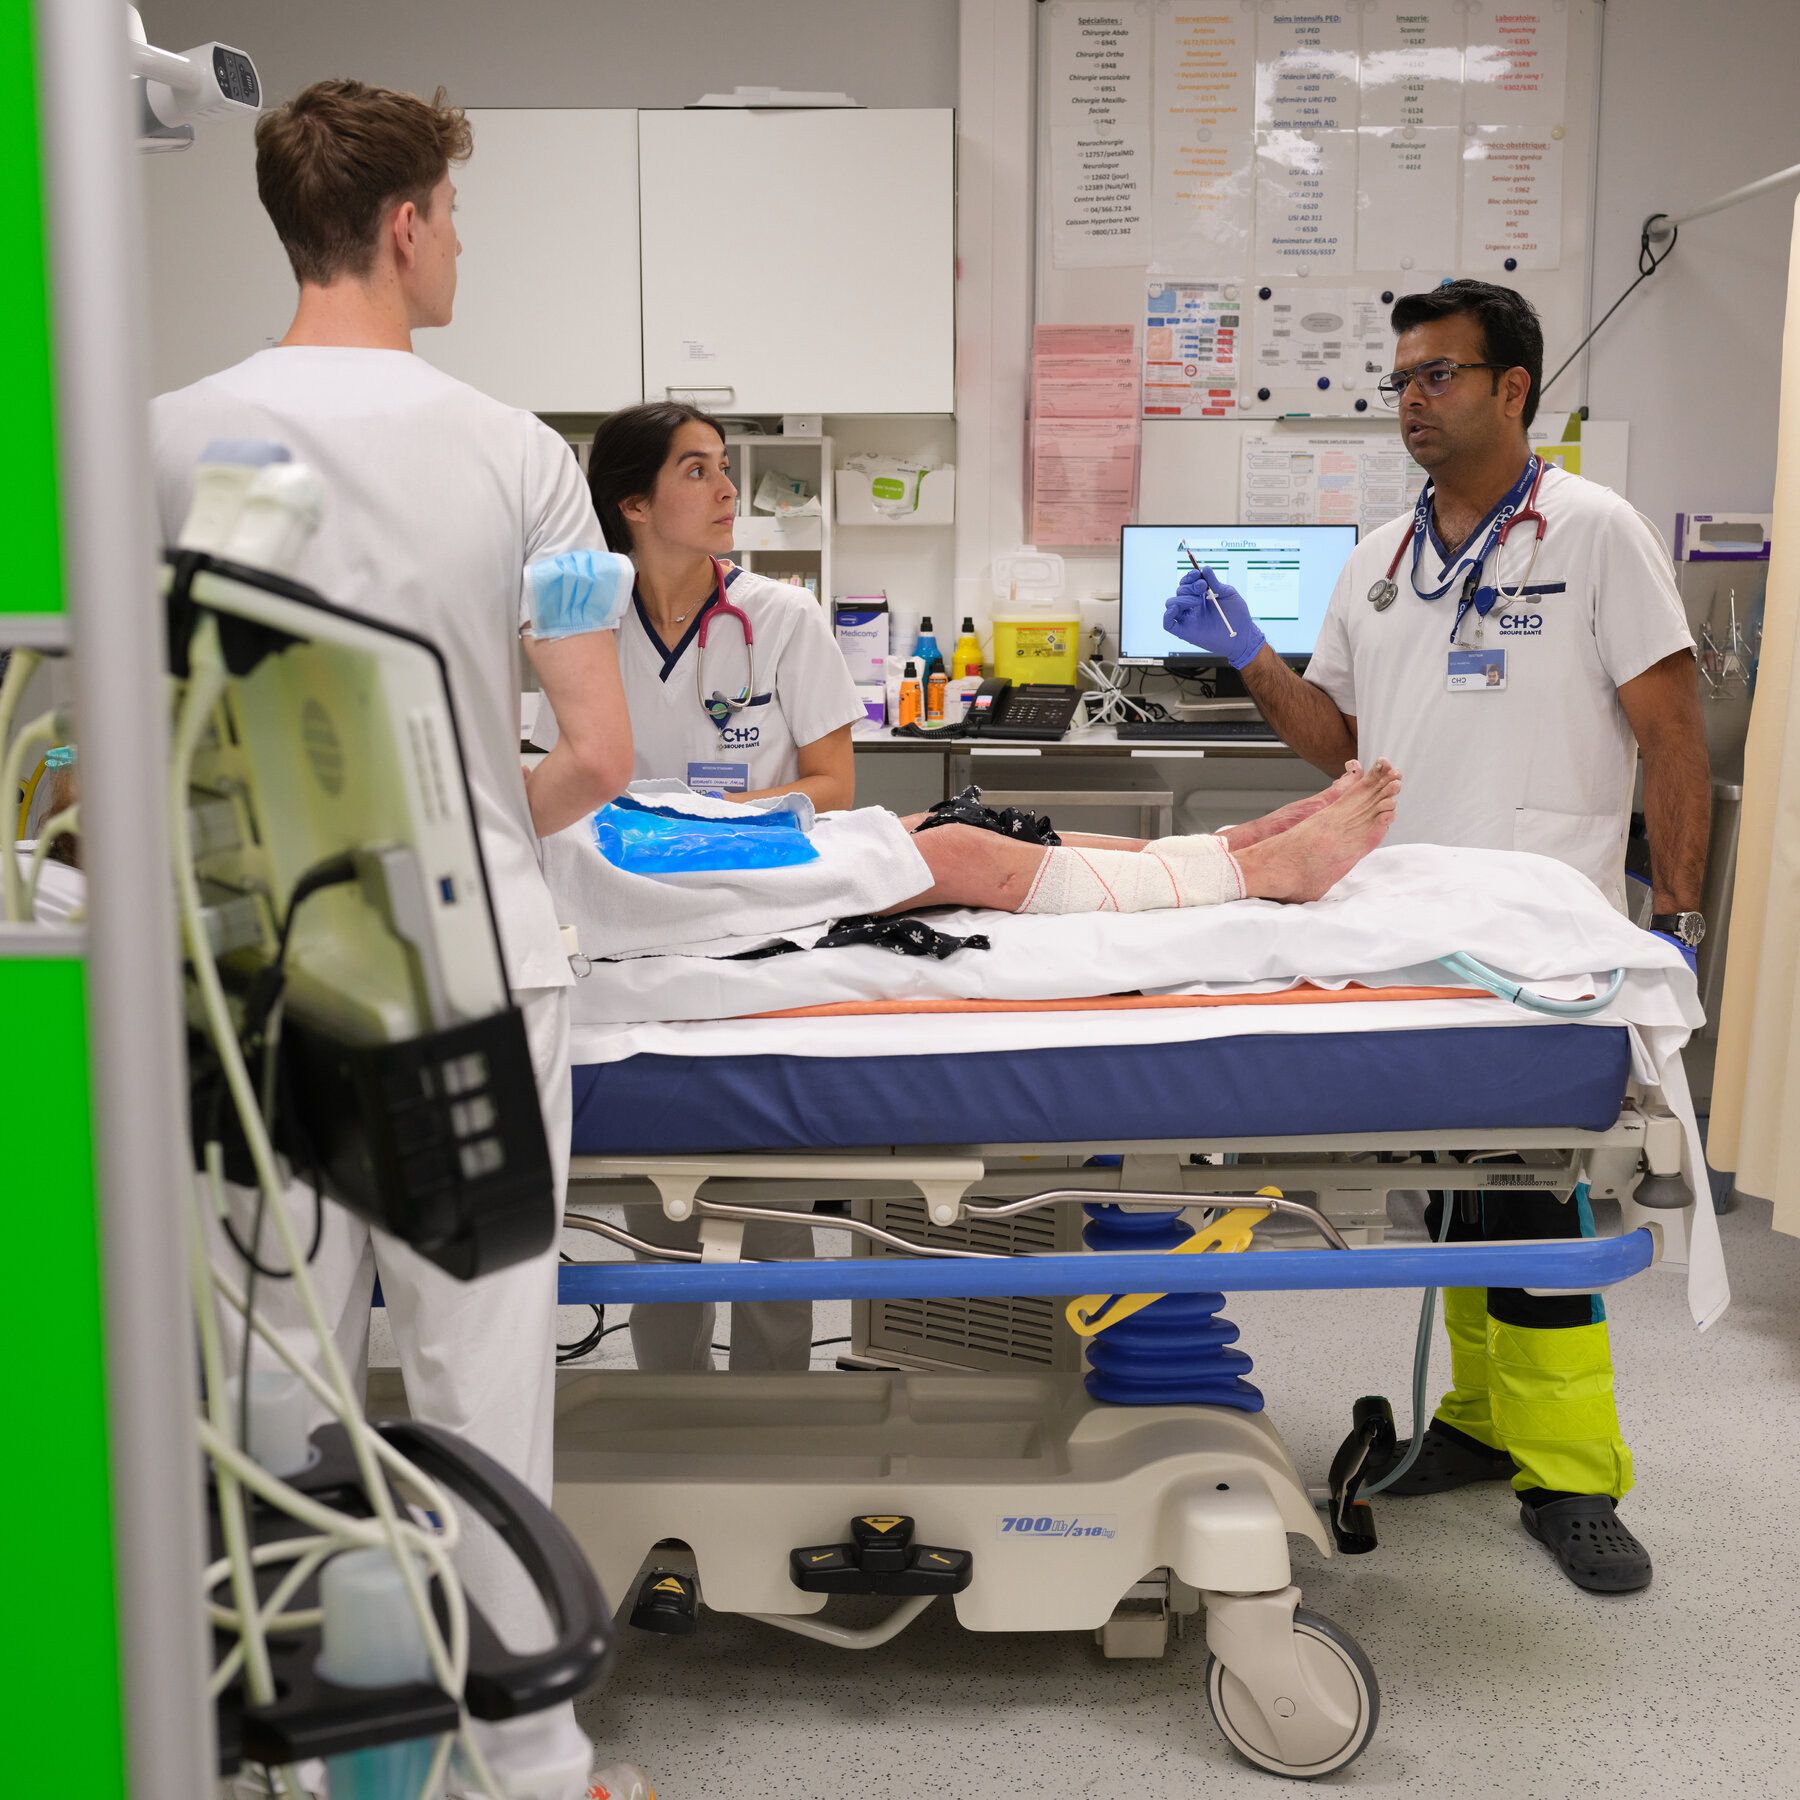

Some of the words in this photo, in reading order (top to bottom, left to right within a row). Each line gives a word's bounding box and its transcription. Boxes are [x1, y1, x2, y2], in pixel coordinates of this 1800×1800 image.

[1078, 17, 1118, 25] Spécialistes
[1274, 15, 1292, 23] Soins
[1294, 15, 1323, 23] intensifs
[1082, 29, 1111, 37] Chirurgie
[1076, 51, 1104, 59] Chirurgie
[1273, 120, 1291, 128] Soins
[1293, 120, 1322, 128] intensifs
[1220, 540, 1257, 548] OmniPro
[840, 630, 878, 638] Medicomp
